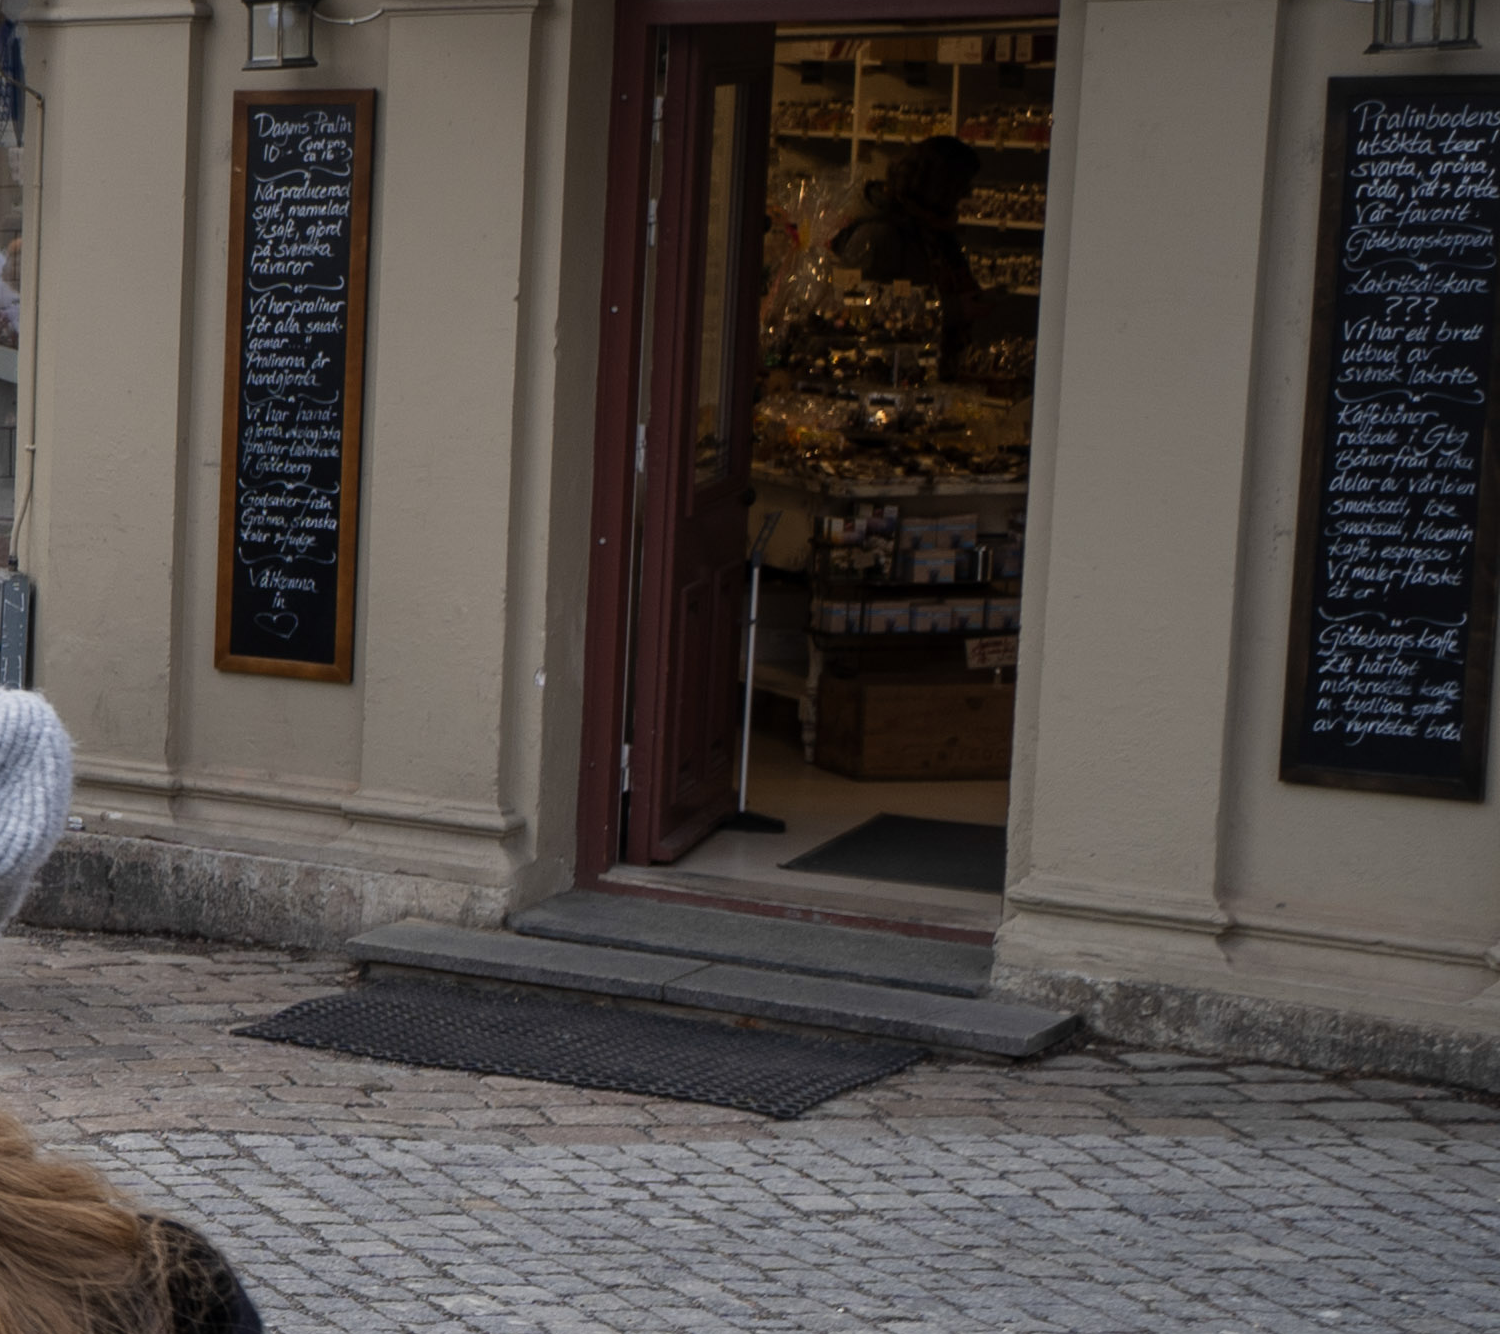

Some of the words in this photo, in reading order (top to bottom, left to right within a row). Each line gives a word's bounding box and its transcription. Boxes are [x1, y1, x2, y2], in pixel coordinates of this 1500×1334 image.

[303, 111, 353, 135] Pralin
[1356, 132, 1436, 155] utsökta
[1350, 155, 1423, 180] svarta,
[1421, 153, 1496, 184] gröna,
[1356, 201, 1393, 225] Vår
[251, 239, 273, 267] på
[274, 239, 335, 258] svenska
[252, 258, 314, 275] råvaror
[250, 291, 271, 314] Vi
[1344, 316, 1371, 342] Vi
[1368, 320, 1405, 341] har
[1405, 325, 1430, 342] ett
[1436, 320, 1484, 342] brett
[1341, 342, 1401, 364] utbud
[1407, 345, 1441, 363] av
[1337, 364, 1403, 382] svensk
[1407, 363, 1479, 385] lakrits
